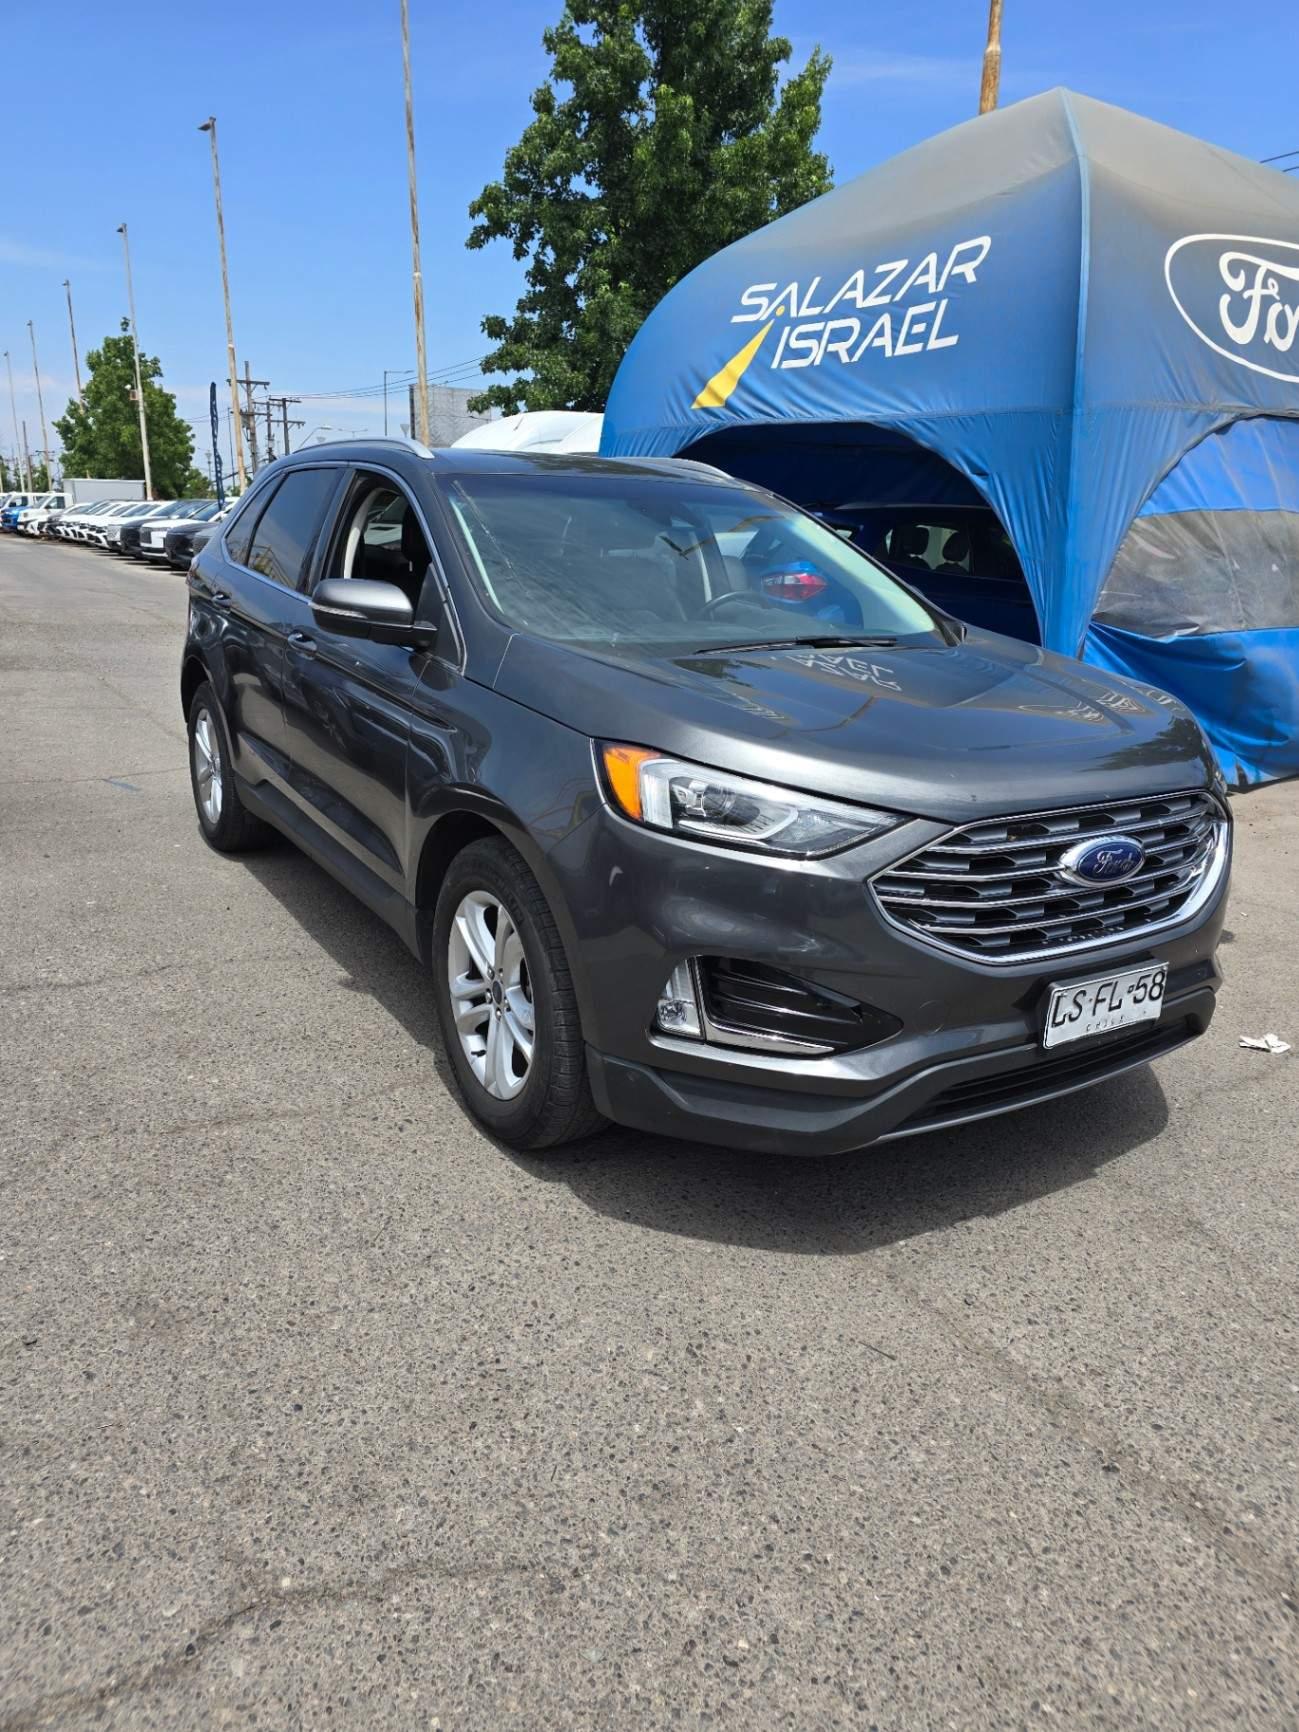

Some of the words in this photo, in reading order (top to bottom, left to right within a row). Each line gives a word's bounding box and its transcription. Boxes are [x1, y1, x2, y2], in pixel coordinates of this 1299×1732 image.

[730, 235, 992, 323] SALAZAR
[1219, 251, 1299, 352] Fo
[771, 299, 959, 369] ISRAEL
